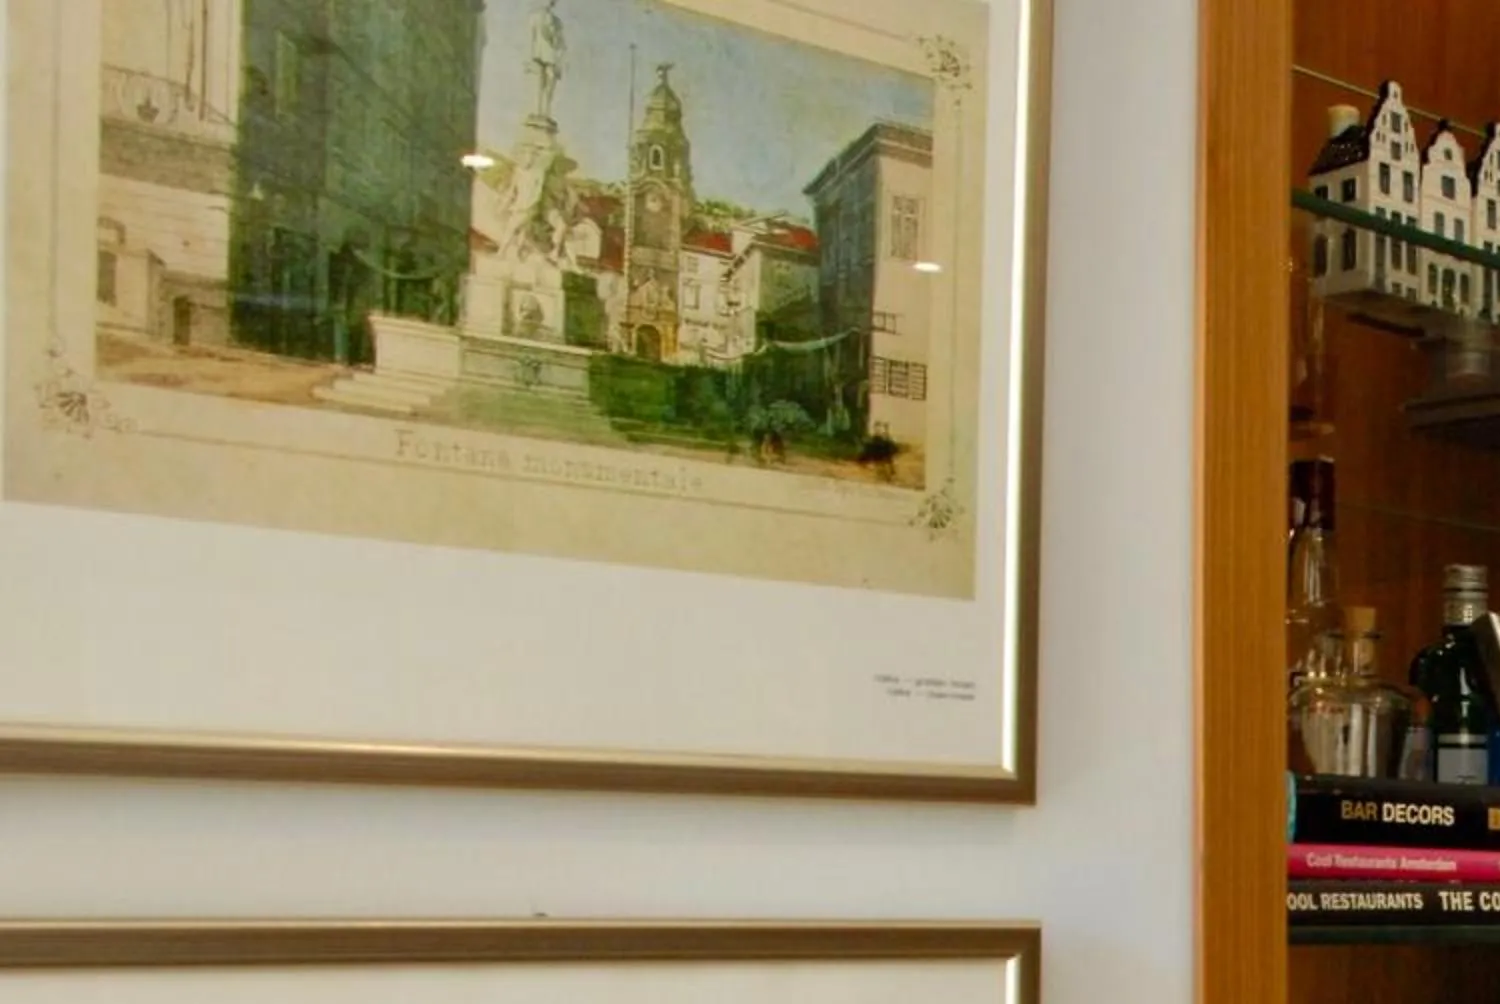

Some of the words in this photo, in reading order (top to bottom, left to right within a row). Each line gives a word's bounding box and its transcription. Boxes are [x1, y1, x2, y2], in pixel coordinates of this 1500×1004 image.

[1341, 800, 1379, 822] BAR
[1382, 802, 1455, 826] DECORS
[1306, 852, 1332, 868] Cool
[1335, 853, 1397, 870] Restaurants
[1400, 855, 1457, 872] Amsterdam
[1286, 892, 1318, 910] OOL
[1320, 892, 1424, 910] RESTAURANTS
[1438, 891, 1475, 911] THE
